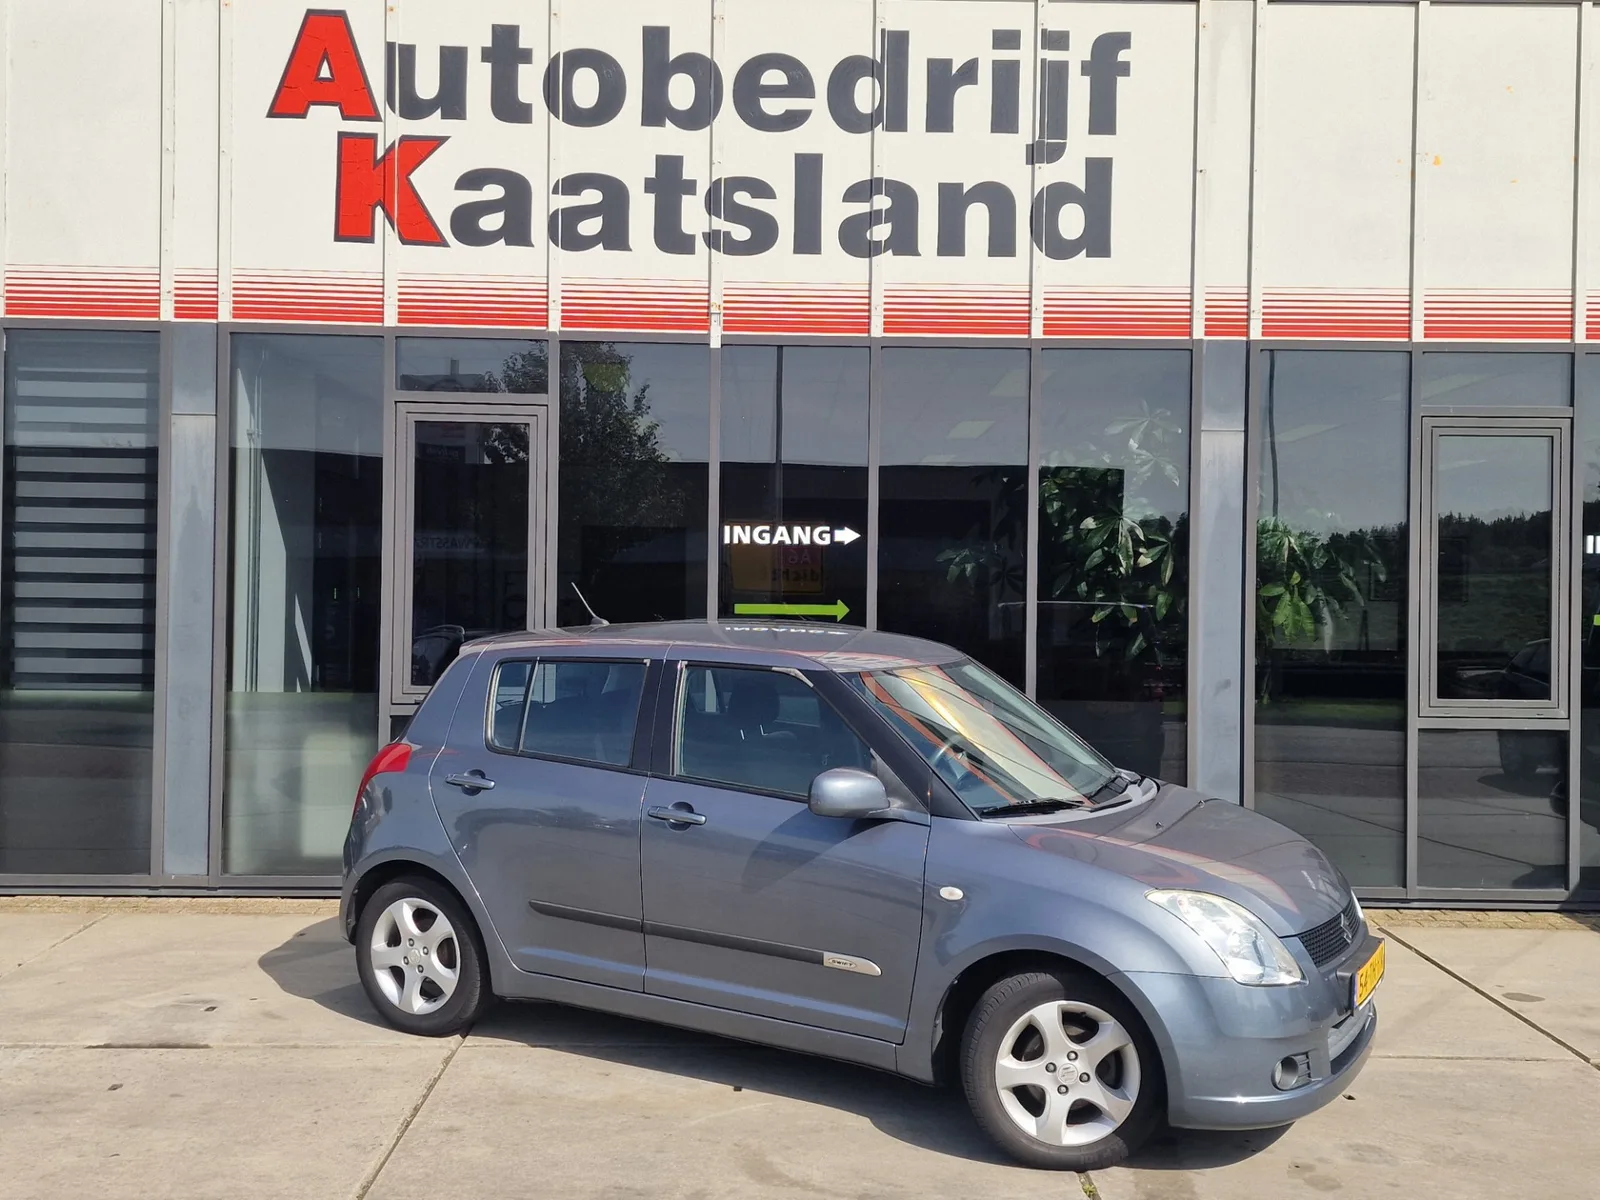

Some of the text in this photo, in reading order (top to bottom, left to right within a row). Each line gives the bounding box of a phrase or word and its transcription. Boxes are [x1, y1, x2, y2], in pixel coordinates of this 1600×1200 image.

[266, 8, 1131, 165] Autobedrijf
[334, 131, 1113, 260] Kaatsland
[724, 525, 831, 545] INGANG
[831, 959, 853, 967] SWIFT
